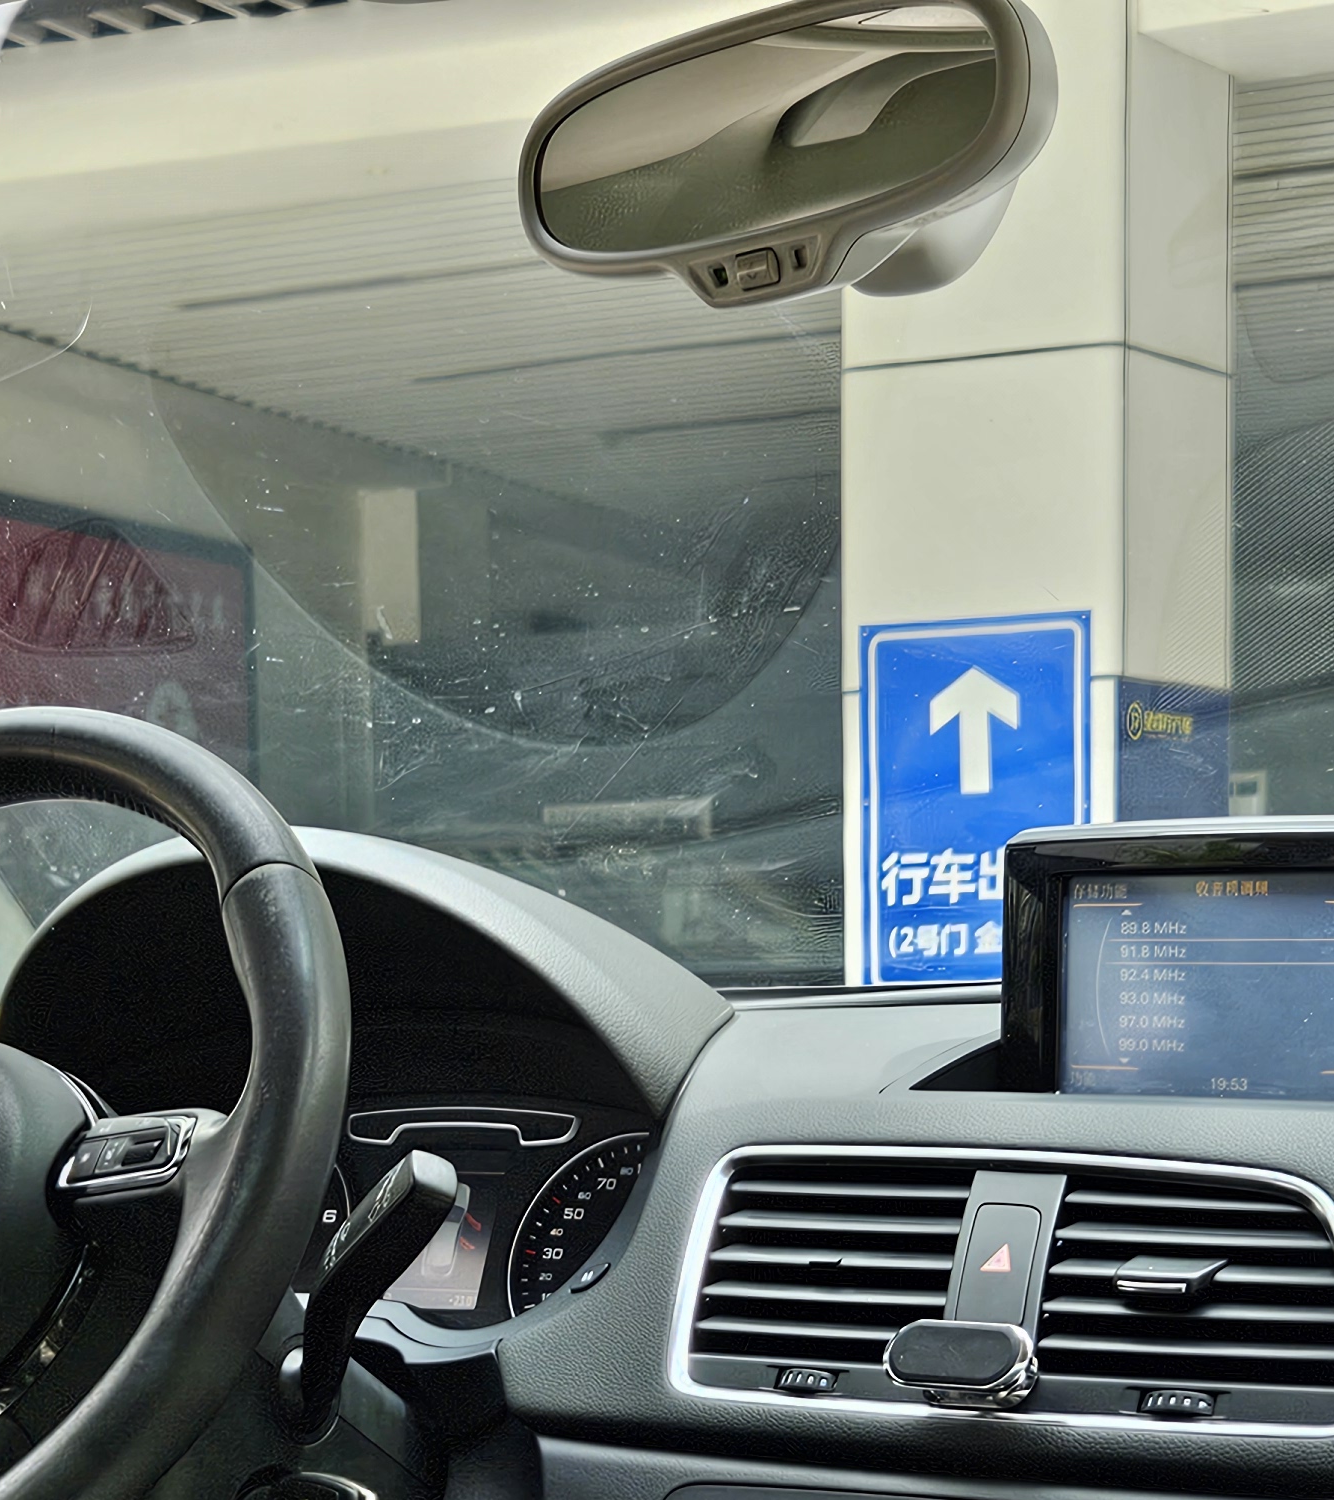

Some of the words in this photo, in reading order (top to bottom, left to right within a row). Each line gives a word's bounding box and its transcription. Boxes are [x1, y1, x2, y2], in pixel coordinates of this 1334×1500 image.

[1153, 921, 1187, 935] MHz
[1120, 945, 1150, 958] 91.8
[1153, 945, 1187, 958] MHz
[1119, 968, 1150, 982] 92.4
[1153, 968, 1186, 981] MHz
[1119, 992, 1149, 1005] 93.0
[1152, 992, 1186, 1005] MHz
[1119, 1015, 1149, 1028] 97.0
[1151, 1015, 1185, 1028] MHz
[1118, 1039, 1148, 1052] 99.0
[1151, 1039, 1185, 1052] MHz
[1210, 1077, 1249, 1091] 19:53
[597, 1177, 617, 1190] 70
[577, 1191, 592, 1200] 60
[322, 1209, 338, 1223] 6
[563, 1208, 584, 1220] 50
[549, 1228, 564, 1236] 40
[542, 1248, 563, 1259] 30
[539, 1272, 553, 1281] 20
